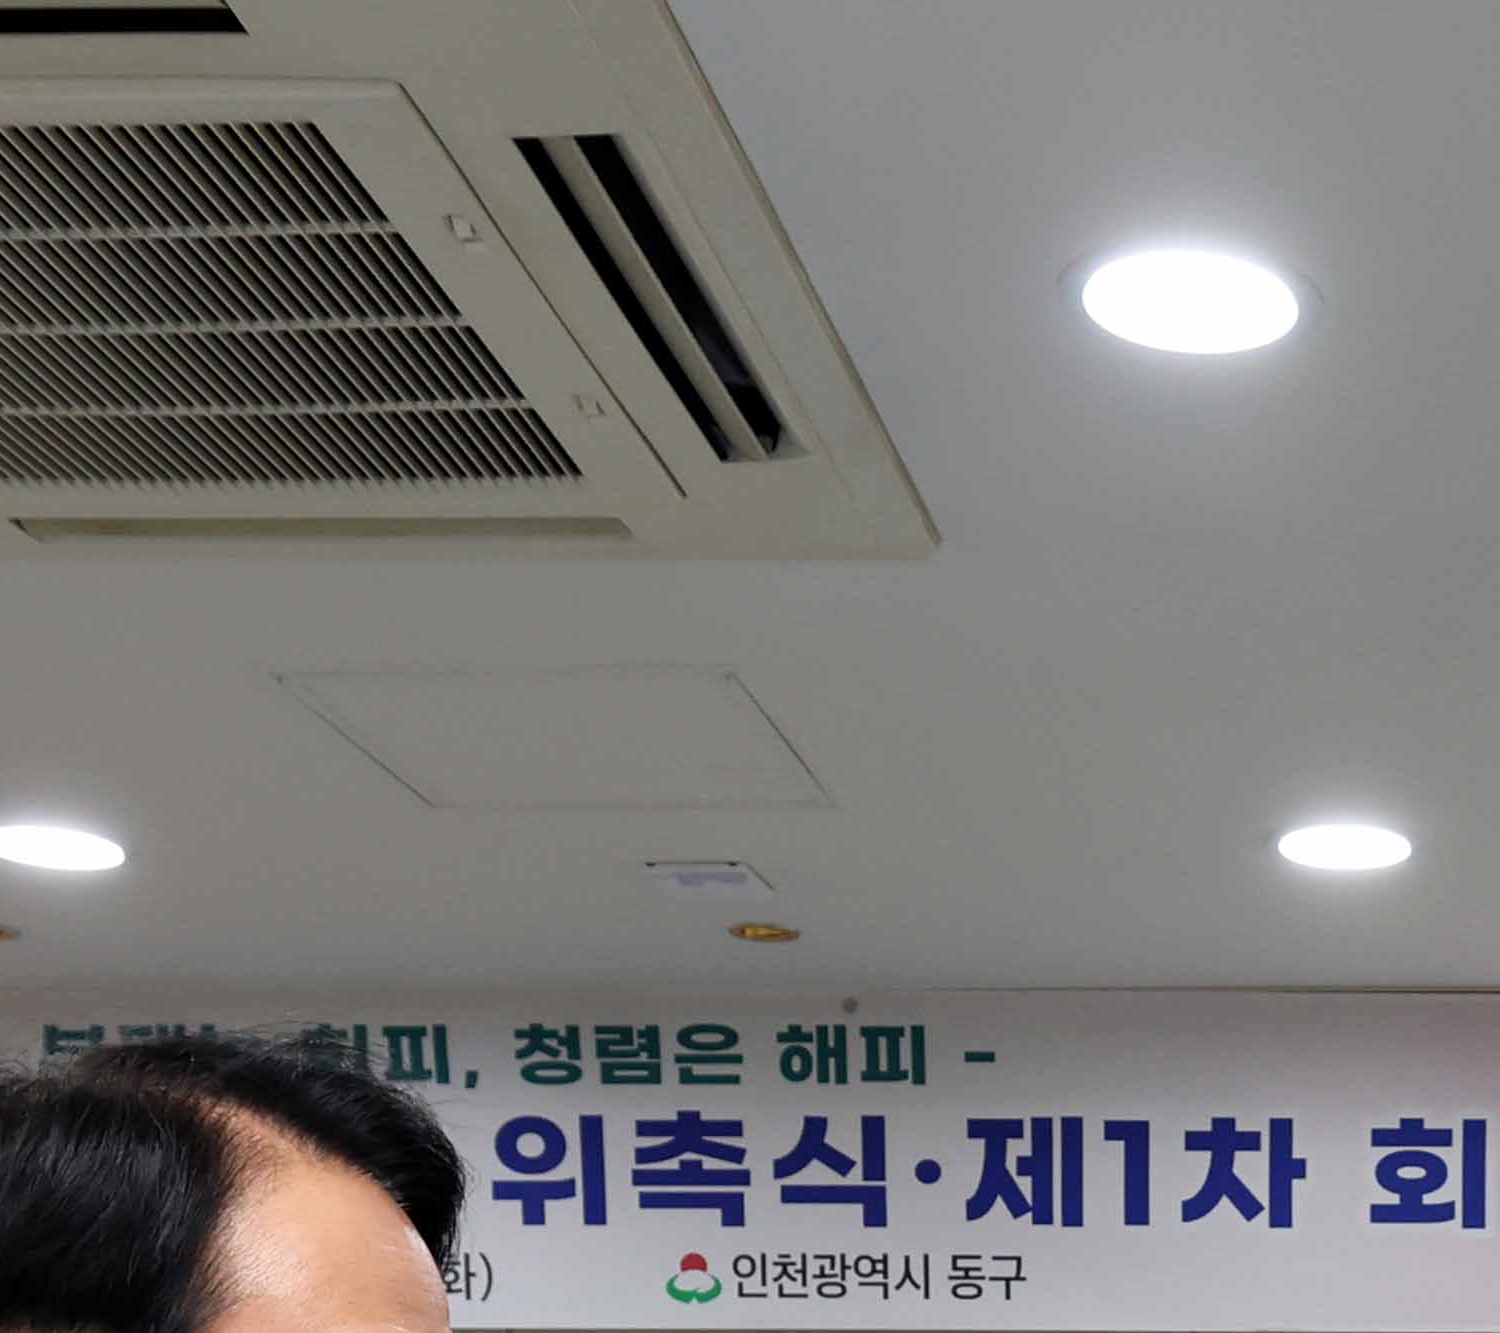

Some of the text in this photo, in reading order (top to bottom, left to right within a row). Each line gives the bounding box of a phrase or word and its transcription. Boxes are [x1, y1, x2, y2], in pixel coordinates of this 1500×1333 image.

[513, 1023, 744, 1087] 청렴은
[776, 1023, 928, 1086] 해피
[731, 1251, 931, 1300] 인천광역시
[946, 1252, 1029, 1300] 동구
